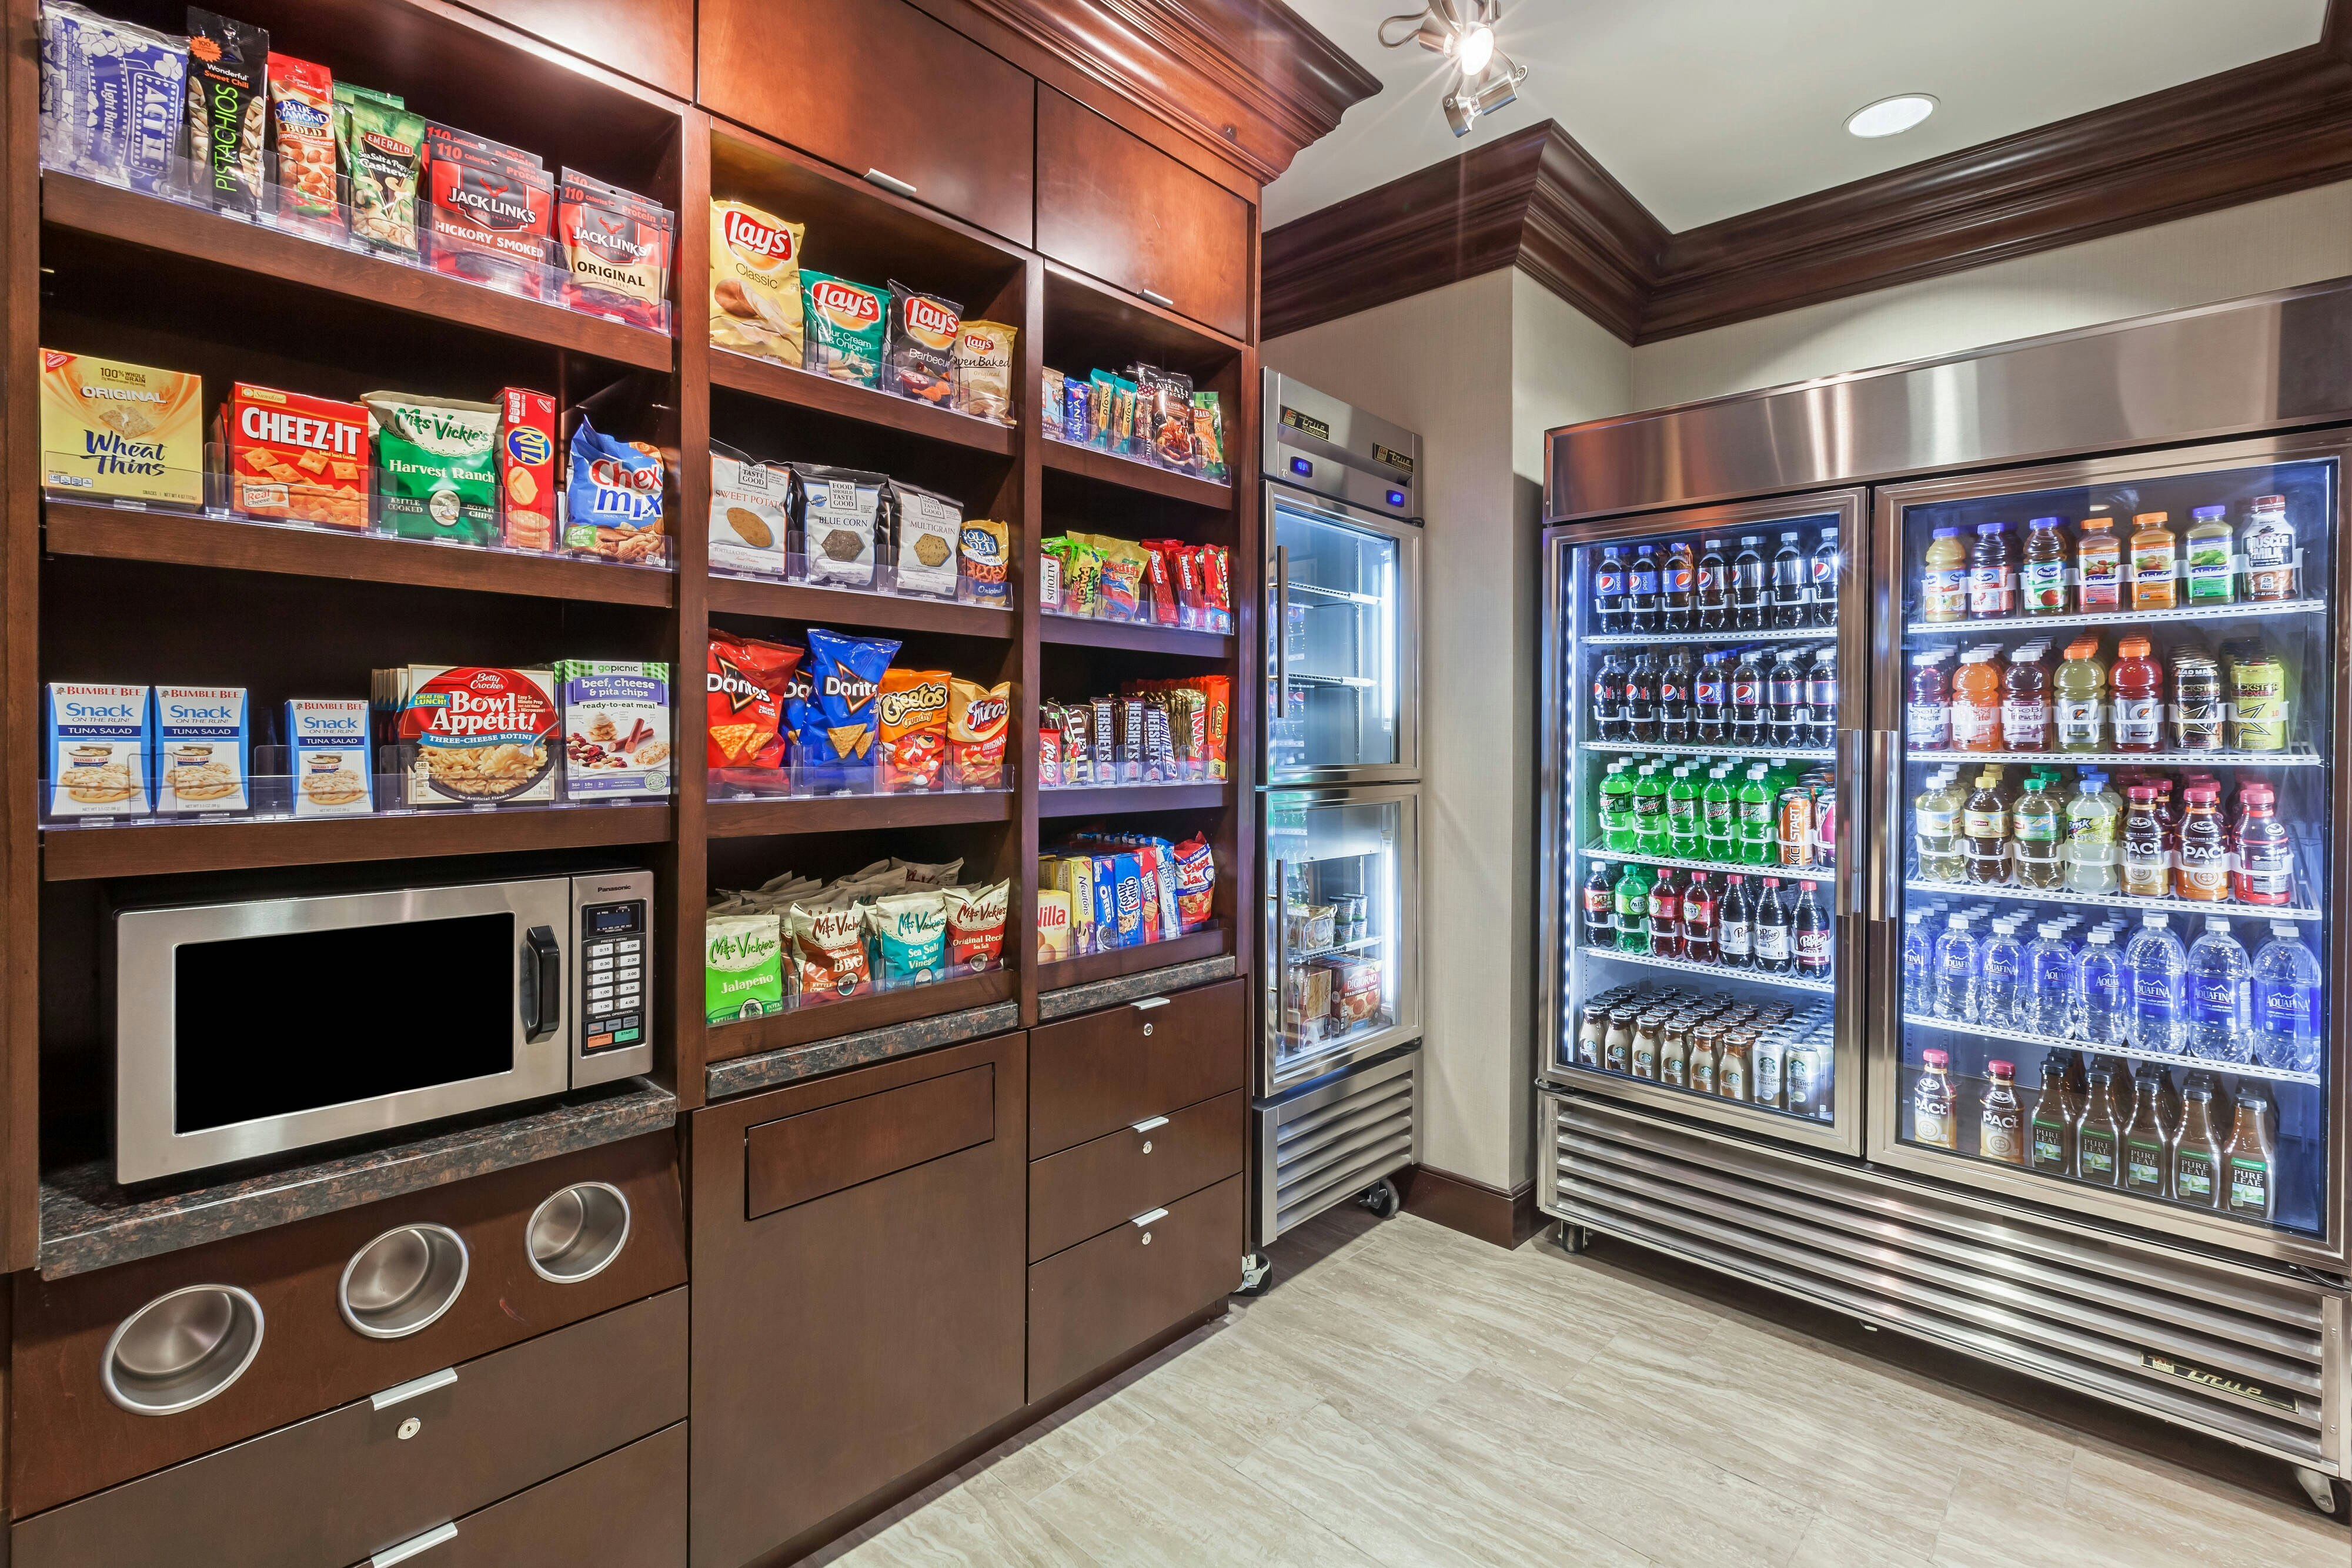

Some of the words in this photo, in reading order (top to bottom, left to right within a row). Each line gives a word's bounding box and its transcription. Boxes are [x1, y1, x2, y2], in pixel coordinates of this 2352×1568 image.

[204, 70, 229, 83] Sweet
[232, 79, 249, 89] Chili
[207, 63, 247, 81] Wonderful
[101, 82, 118, 111] Light
[143, 84, 168, 134] ACT
[275, 109, 329, 123] DIAMOND
[283, 101, 313, 115] BLUE
[215, 83, 238, 192] PISTACHIOS
[285, 123, 322, 136] BOLD
[142, 134, 165, 162] II
[368, 135, 410, 153] EMERALD
[436, 143, 462, 159] 110
[465, 153, 490, 165] calories
[359, 158, 415, 180] Cashews
[506, 166, 547, 186] Protein
[565, 186, 584, 201] 110
[449, 186, 491, 211] JACK
[491, 199, 536, 223] LINK'S
[622, 206, 656, 223] Protein
[435, 220, 493, 243] HICKORY
[497, 238, 544, 258] SMOKED
[573, 226, 609, 248] JACK
[610, 235, 647, 257] LINK'S
[729, 211, 789, 256] Lay's
[577, 261, 645, 287] ORIGINAL
[736, 263, 778, 289] Classic
[818, 283, 875, 319] Lay's
[909, 299, 959, 336] Lay's
[836, 338, 863, 353] Onion
[843, 330, 871, 348] Cream
[966, 337, 994, 351] Lay's
[100, 367, 124, 378] 100%
[81, 386, 167, 404] ORIGINAL
[242, 407, 361, 454] CHEEZ-IT
[433, 414, 489, 446] Vickie's
[1299, 415, 1328, 434] true
[83, 429, 165, 460] Wheat
[513, 426, 546, 464] RITZ
[81, 456, 165, 477] Thins
[389, 459, 447, 479] Harvest
[452, 466, 495, 484] Ranch
[743, 470, 764, 479] TASTE
[590, 460, 662, 491] Chex
[742, 477, 764, 485] GOOD
[248, 489, 270, 500] Real
[597, 488, 662, 517] mix
[716, 490, 749, 503] SWEET
[388, 503, 423, 513] COOKED
[819, 516, 840, 525] BLUE
[843, 519, 868, 527] CORN
[910, 520, 956, 535] MULTIGRAIN
[978, 586, 1003, 594] Original
[470, 680, 504, 690] Crocker
[477, 673, 500, 686] Betty
[582, 678, 612, 688] beef,
[614, 678, 655, 689] cheese
[707, 673, 770, 701] Doritos
[67, 686, 118, 696] BUMBLE
[120, 688, 141, 697] BEE
[171, 689, 217, 698] BUMBLE
[622, 689, 649, 697] chips
[305, 702, 342, 711] BUMBLE
[449, 690, 515, 713] Bowl
[881, 686, 944, 723] Cheetos
[66, 703, 133, 718] Snack
[169, 706, 232, 719] Snack
[303, 717, 358, 729] Snack
[429, 707, 536, 735] Appétit!
[903, 712, 932, 728] Crunchy
[1216, 701, 1227, 740] Reese's
[429, 735, 498, 744] THREE-CHEESE
[1078, 876, 1089, 916] Newtons
[1125, 877, 1138, 905] Chips
[1098, 885, 1111, 923] OREO
[953, 936, 983, 946] Original
[908, 948, 921, 958] Sea
[924, 943, 939, 954] Salt
[833, 955, 863, 972] BBQ
[908, 956, 938, 969] Vinegar
[721, 974, 773, 994] Jalapeño
[2266, 995, 2310, 1012] AQUAFINA
[2084, 1138, 2110, 1150] PURE
[2131, 1149, 2157, 1161] PURE
[2131, 1156, 2156, 1166] LEAF
[2181, 1159, 2209, 1171] PURE
[2181, 1166, 2207, 1177] LEAF
[2234, 1169, 2263, 1181] PURE
[2234, 1176, 2261, 1187] LEAF
